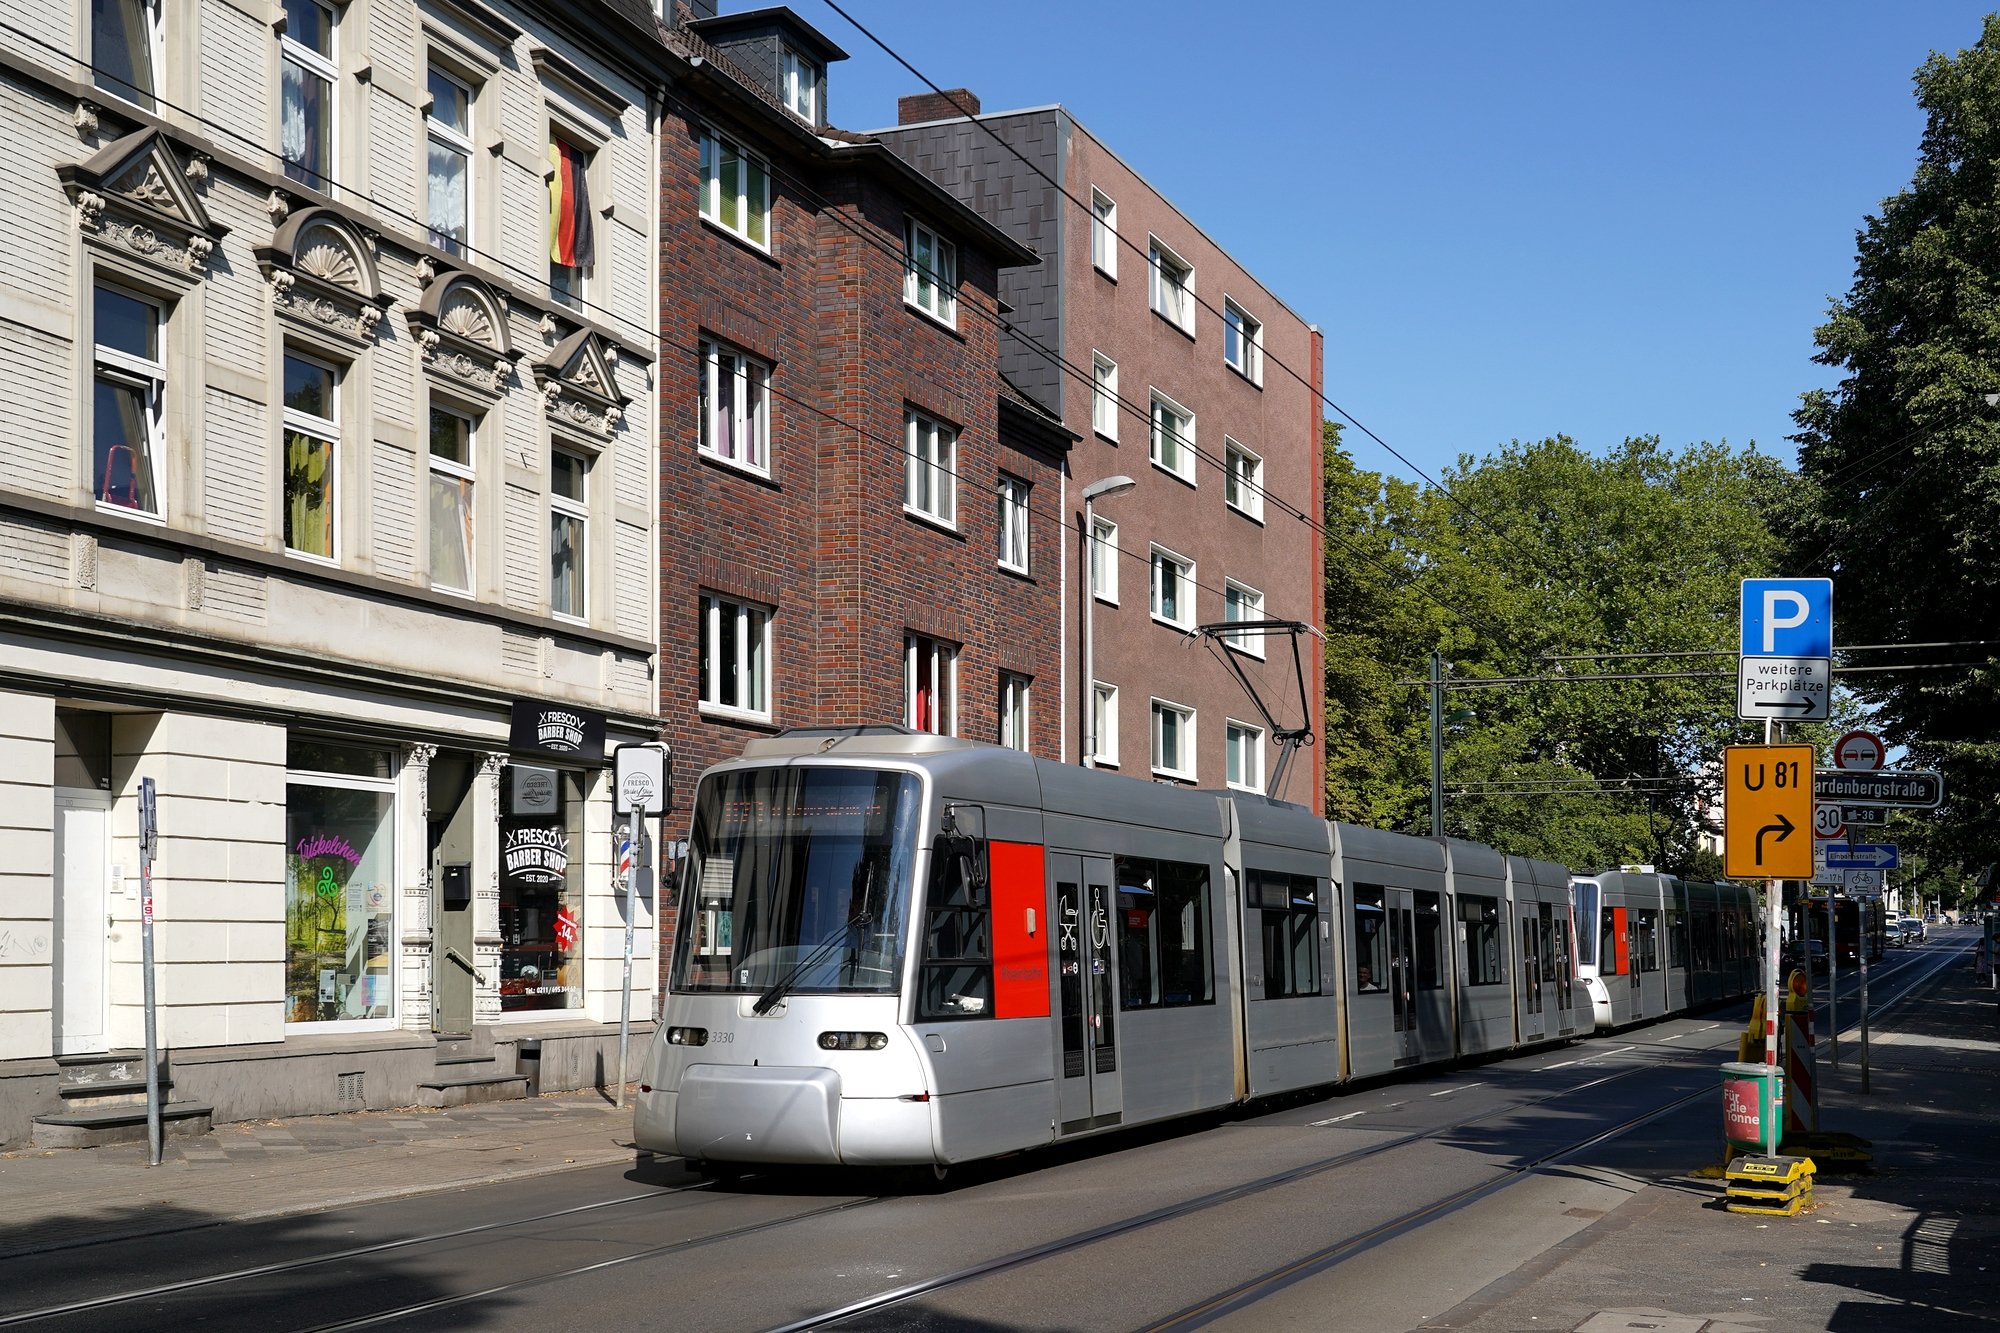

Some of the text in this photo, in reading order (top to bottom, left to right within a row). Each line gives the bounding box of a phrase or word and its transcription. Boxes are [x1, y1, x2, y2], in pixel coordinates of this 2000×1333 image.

[1763, 590, 1810, 652] P
[1758, 663, 1813, 675] weitere
[1746, 678, 1824, 693] Parkplätze
[547, 711, 577, 726] FRESCO
[537, 725, 583, 745] BARBER SHOP
[1744, 761, 1799, 791] U 81
[1815, 779, 1926, 798] ardenbergstraße
[1816, 809, 1840, 829] 30
[517, 828, 558, 847] FRESCO
[506, 848, 568, 873] BARBER SHOP
[525, 874, 549, 883] EST. 2020
[711, 1031, 735, 1044] 3330
[1724, 1088, 1740, 1102] Für
[1729, 1101, 1747, 1113] die
[1726, 1109, 1760, 1125] Tonne
